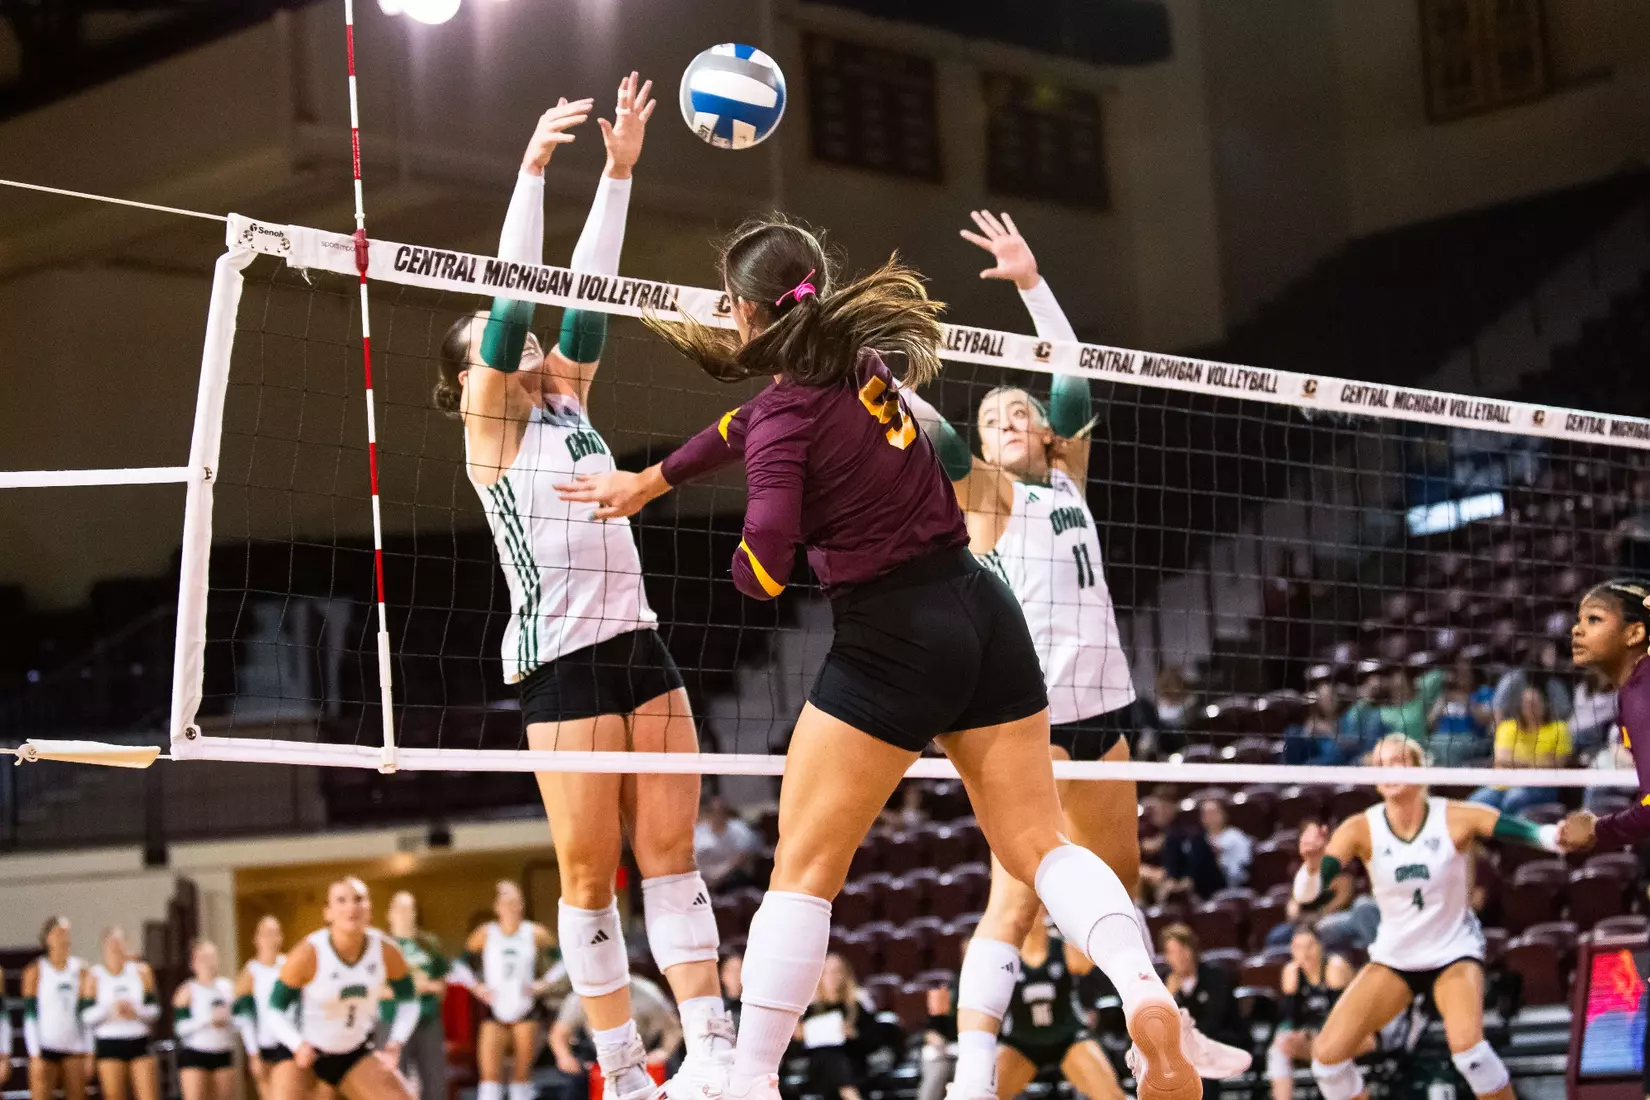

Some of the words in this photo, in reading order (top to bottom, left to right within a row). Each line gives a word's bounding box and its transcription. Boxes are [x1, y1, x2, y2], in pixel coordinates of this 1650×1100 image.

[258, 226, 284, 238] Senoh
[393, 245, 476, 283] CENTRAL
[482, 259, 575, 298] MICHIGAN
[576, 274, 680, 312] VOLLEYBALL
[946, 328, 1005, 357] LEYBALL
[1079, 347, 1135, 374] CENTRAL
[1140, 354, 1202, 384] MICHIGAN
[1206, 365, 1279, 394] VOLLEYBALL
[1340, 383, 1389, 408] CENTRAL
[1393, 391, 1447, 415] MICHIGAN
[1449, 398, 1511, 424] VOLLEYBALL
[1564, 413, 1605, 435] CENTRAL
[1072, 543, 1095, 589] 11
[1412, 887, 1424, 911] 4
